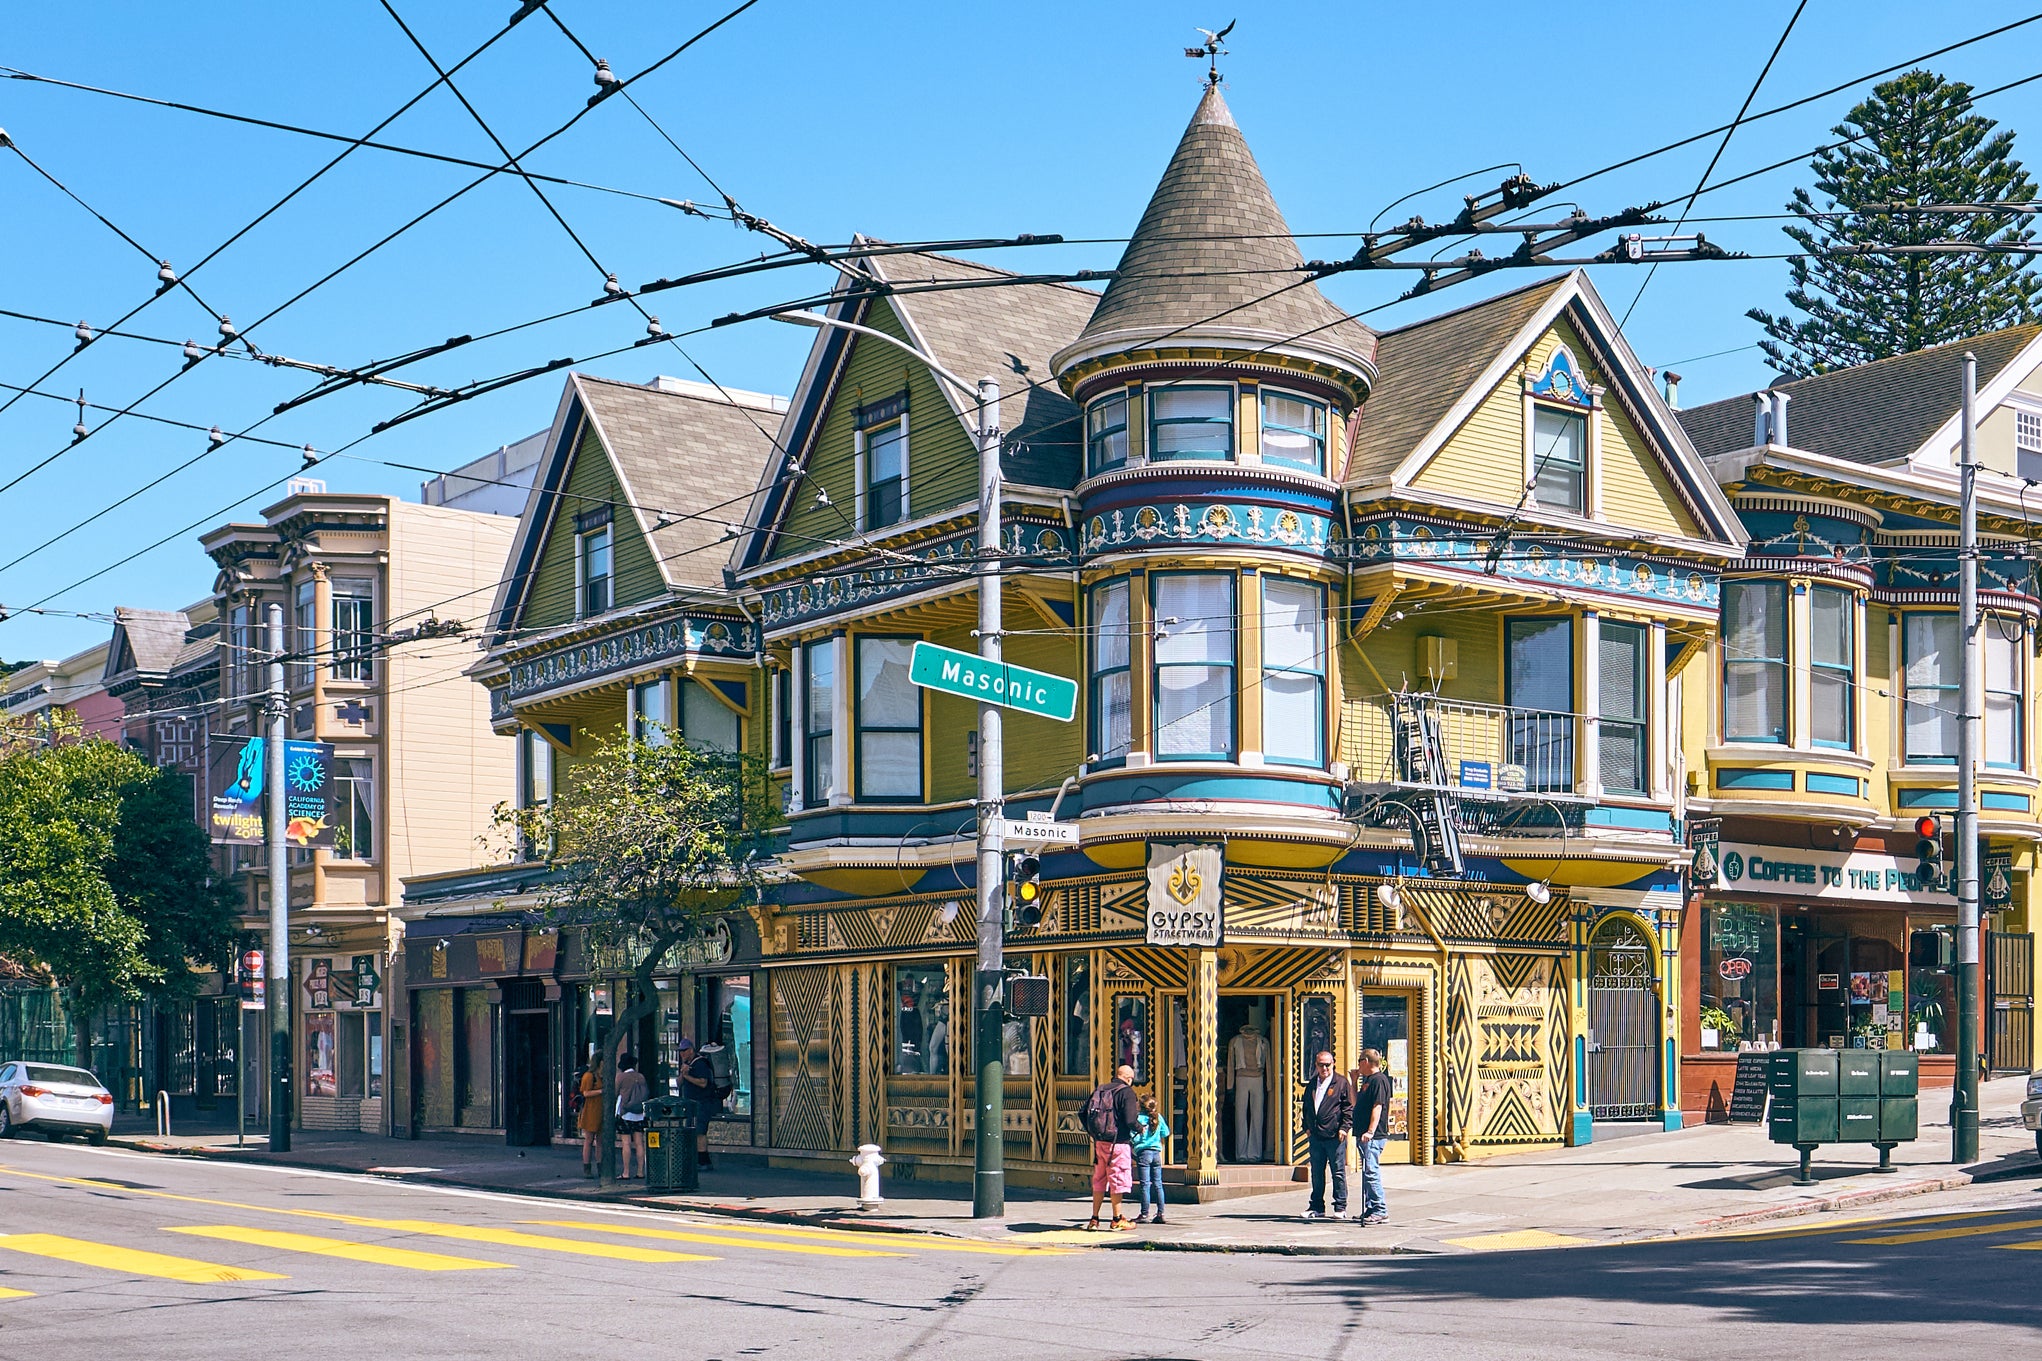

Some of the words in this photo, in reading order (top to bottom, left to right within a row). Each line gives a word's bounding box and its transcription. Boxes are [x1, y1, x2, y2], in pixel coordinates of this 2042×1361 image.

[941, 659, 1047, 705] Masonic
[288, 796, 325, 804] CALIFORNIA
[288, 810, 325, 818] SCIENCES
[1030, 813, 1047, 821] 1200
[213, 814, 263, 829] twilight
[235, 827, 264, 839] zone
[1014, 825, 1067, 838] Masonic
[1693, 832, 1718, 842] COFFEE
[1986, 858, 2011, 866] COFFEE
[1748, 856, 1816, 884] COFFEE
[1820, 866, 1843, 887] TO
[1848, 869, 1881, 890] THE
[1152, 911, 1215, 929] GYPSY
[1717, 917, 1733, 932] TO
[1153, 930, 1214, 939] STREETWEAR
[1712, 932, 1760, 950] PEOPLE
[1720, 960, 1751, 975] OPEN
